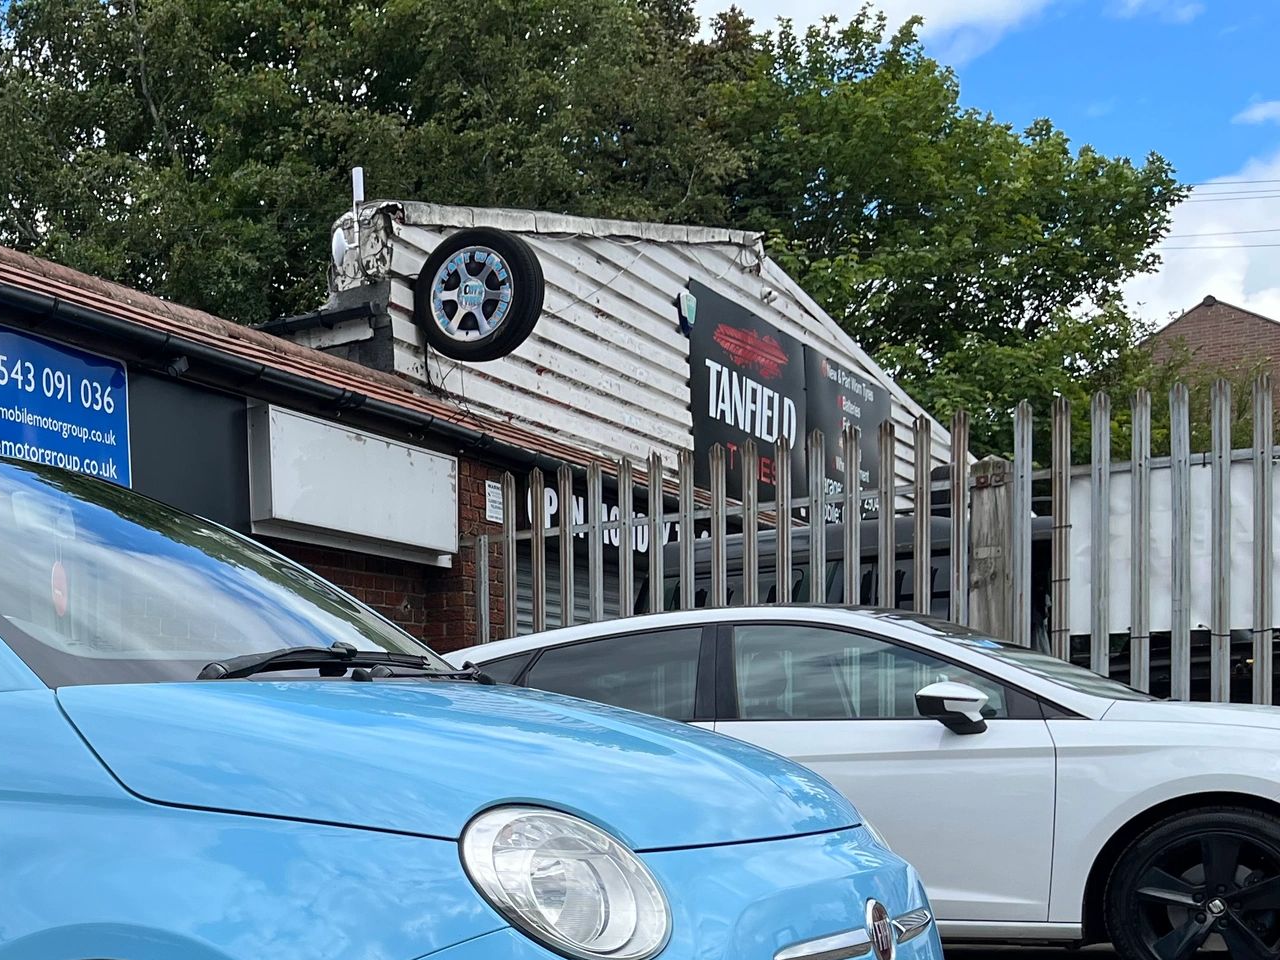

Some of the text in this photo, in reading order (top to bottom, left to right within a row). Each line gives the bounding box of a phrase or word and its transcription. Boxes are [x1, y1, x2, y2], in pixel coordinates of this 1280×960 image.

[42, 367, 72, 403] 091
[80, 379, 115, 414] 036
[705, 358, 797, 450] TANFIELD
